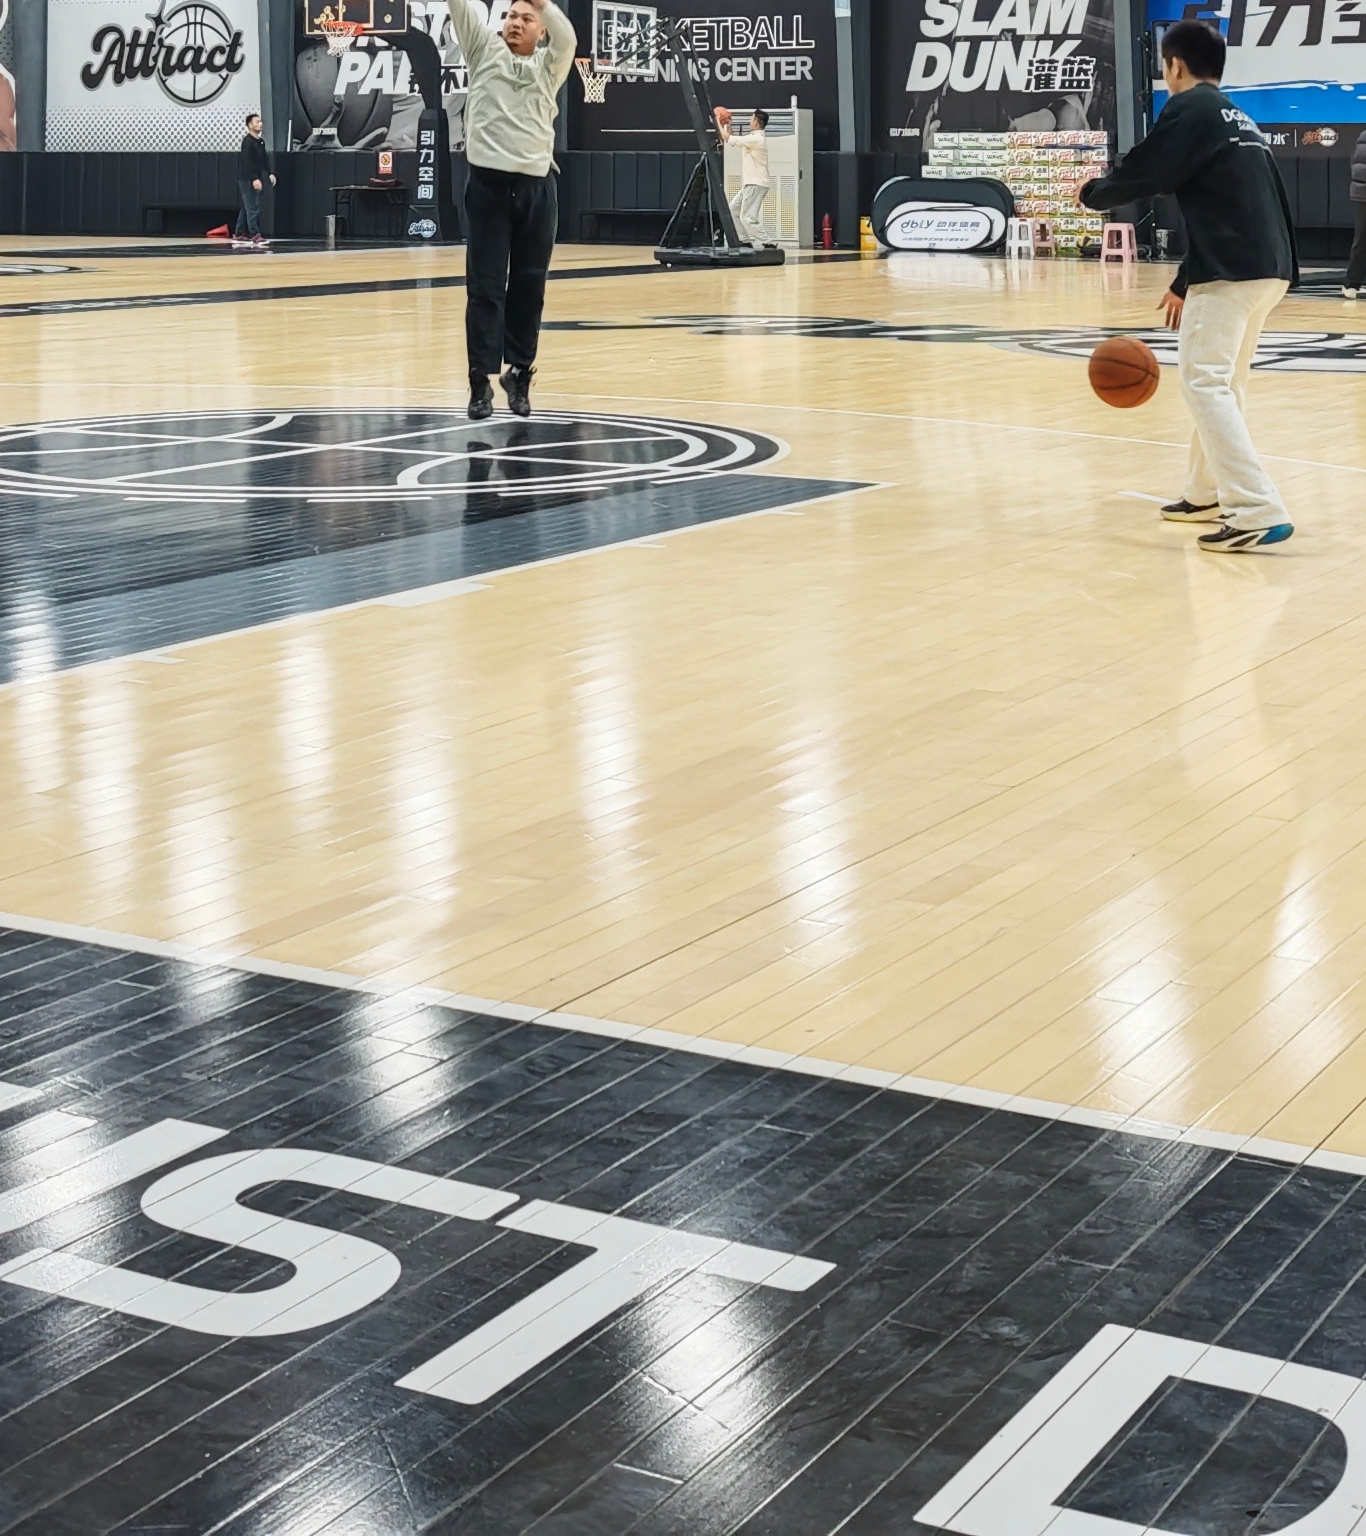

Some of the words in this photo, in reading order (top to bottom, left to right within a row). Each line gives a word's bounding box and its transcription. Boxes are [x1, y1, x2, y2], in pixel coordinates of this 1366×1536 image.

[81, 25, 245, 89] Attract
[715, 56, 813, 82] CENTER
[1022, 56, 1096, 92] 灌篮
[417, 130, 434, 200] 引力空间
